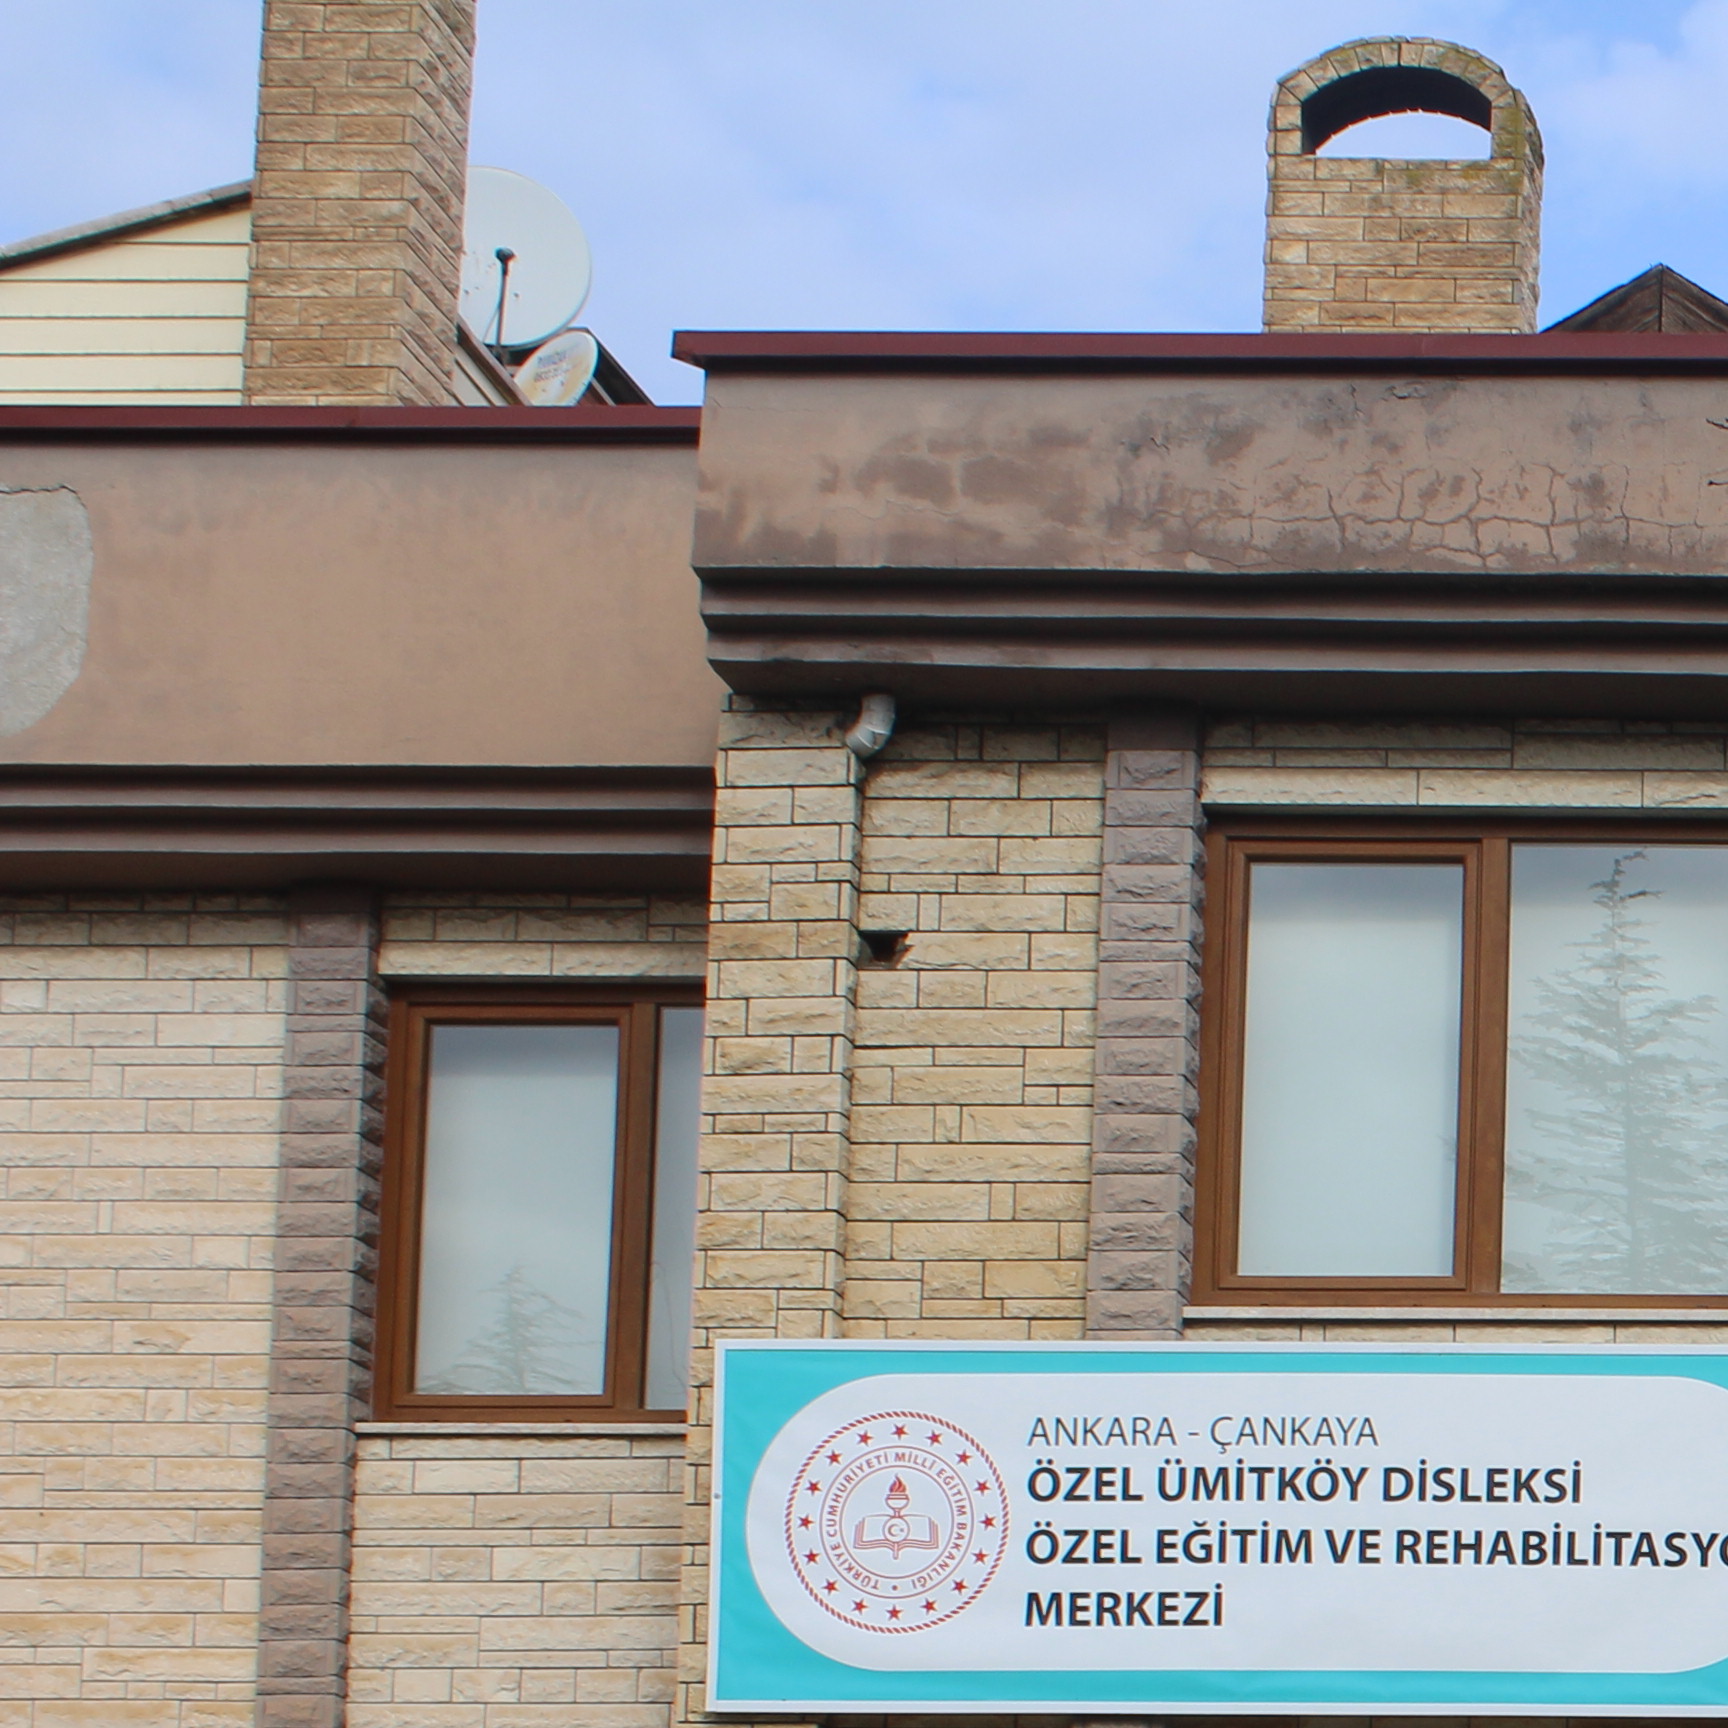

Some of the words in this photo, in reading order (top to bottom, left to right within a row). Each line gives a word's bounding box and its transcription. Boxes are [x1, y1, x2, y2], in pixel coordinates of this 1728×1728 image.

[1027, 1416, 1179, 1447] ANKARA
[1209, 1416, 1380, 1454] ÇANKAYA
[826, 1451, 889, 1538] CUMHURİYETİ
[936, 1468, 968, 1516] EĞİTİM
[1027, 1458, 1145, 1502] ÖZEL
[1157, 1458, 1370, 1502] ÜMİTKÖY
[1382, 1459, 1582, 1504] DİSLEKSİ
[830, 1542, 880, 1590] TÜRKİYE
[911, 1522, 968, 1590] BAKANLIĞI
[1025, 1520, 1143, 1565] ÖZEL
[1156, 1520, 1314, 1565] EĞİTİM
[1325, 1528, 1382, 1565] VE
[1024, 1582, 1224, 1627] MERKEZİ
